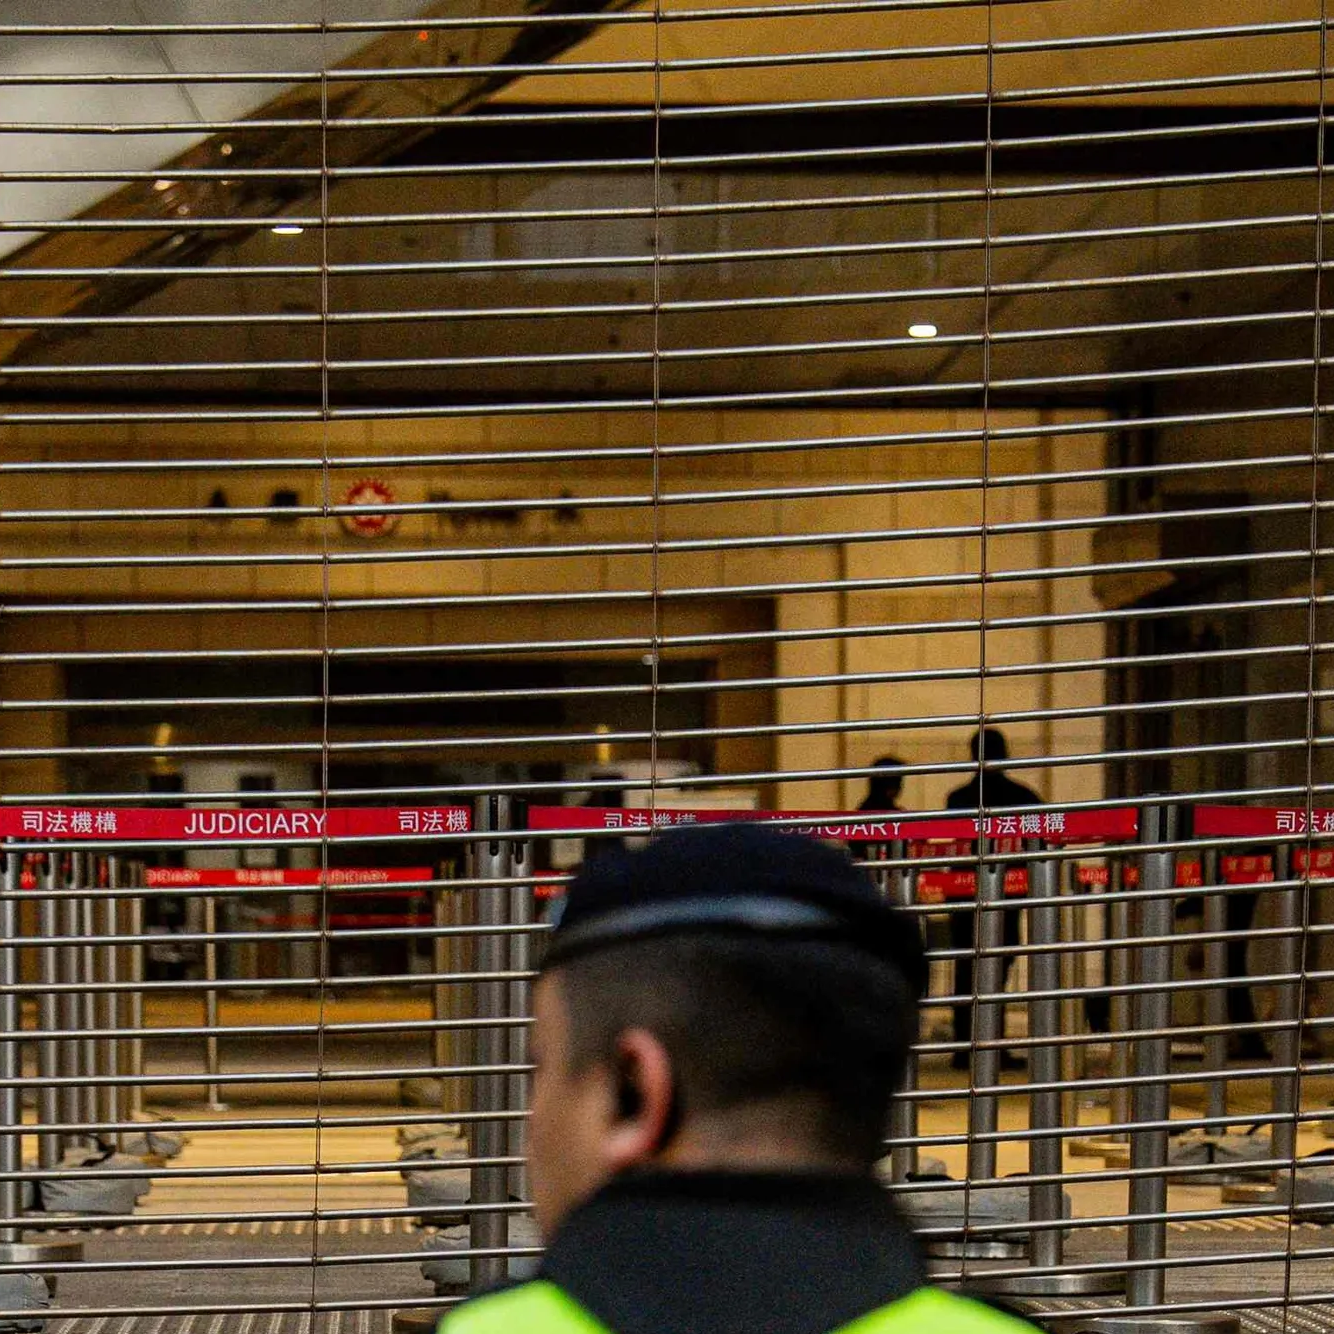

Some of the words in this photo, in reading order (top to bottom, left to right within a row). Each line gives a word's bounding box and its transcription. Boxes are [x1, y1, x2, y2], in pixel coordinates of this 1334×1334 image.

[21, 810, 117, 834] 司法機構
[184, 812, 327, 834] JUDICIARY
[398, 810, 468, 832] 司法機
[972, 812, 1066, 834] 司法機構
